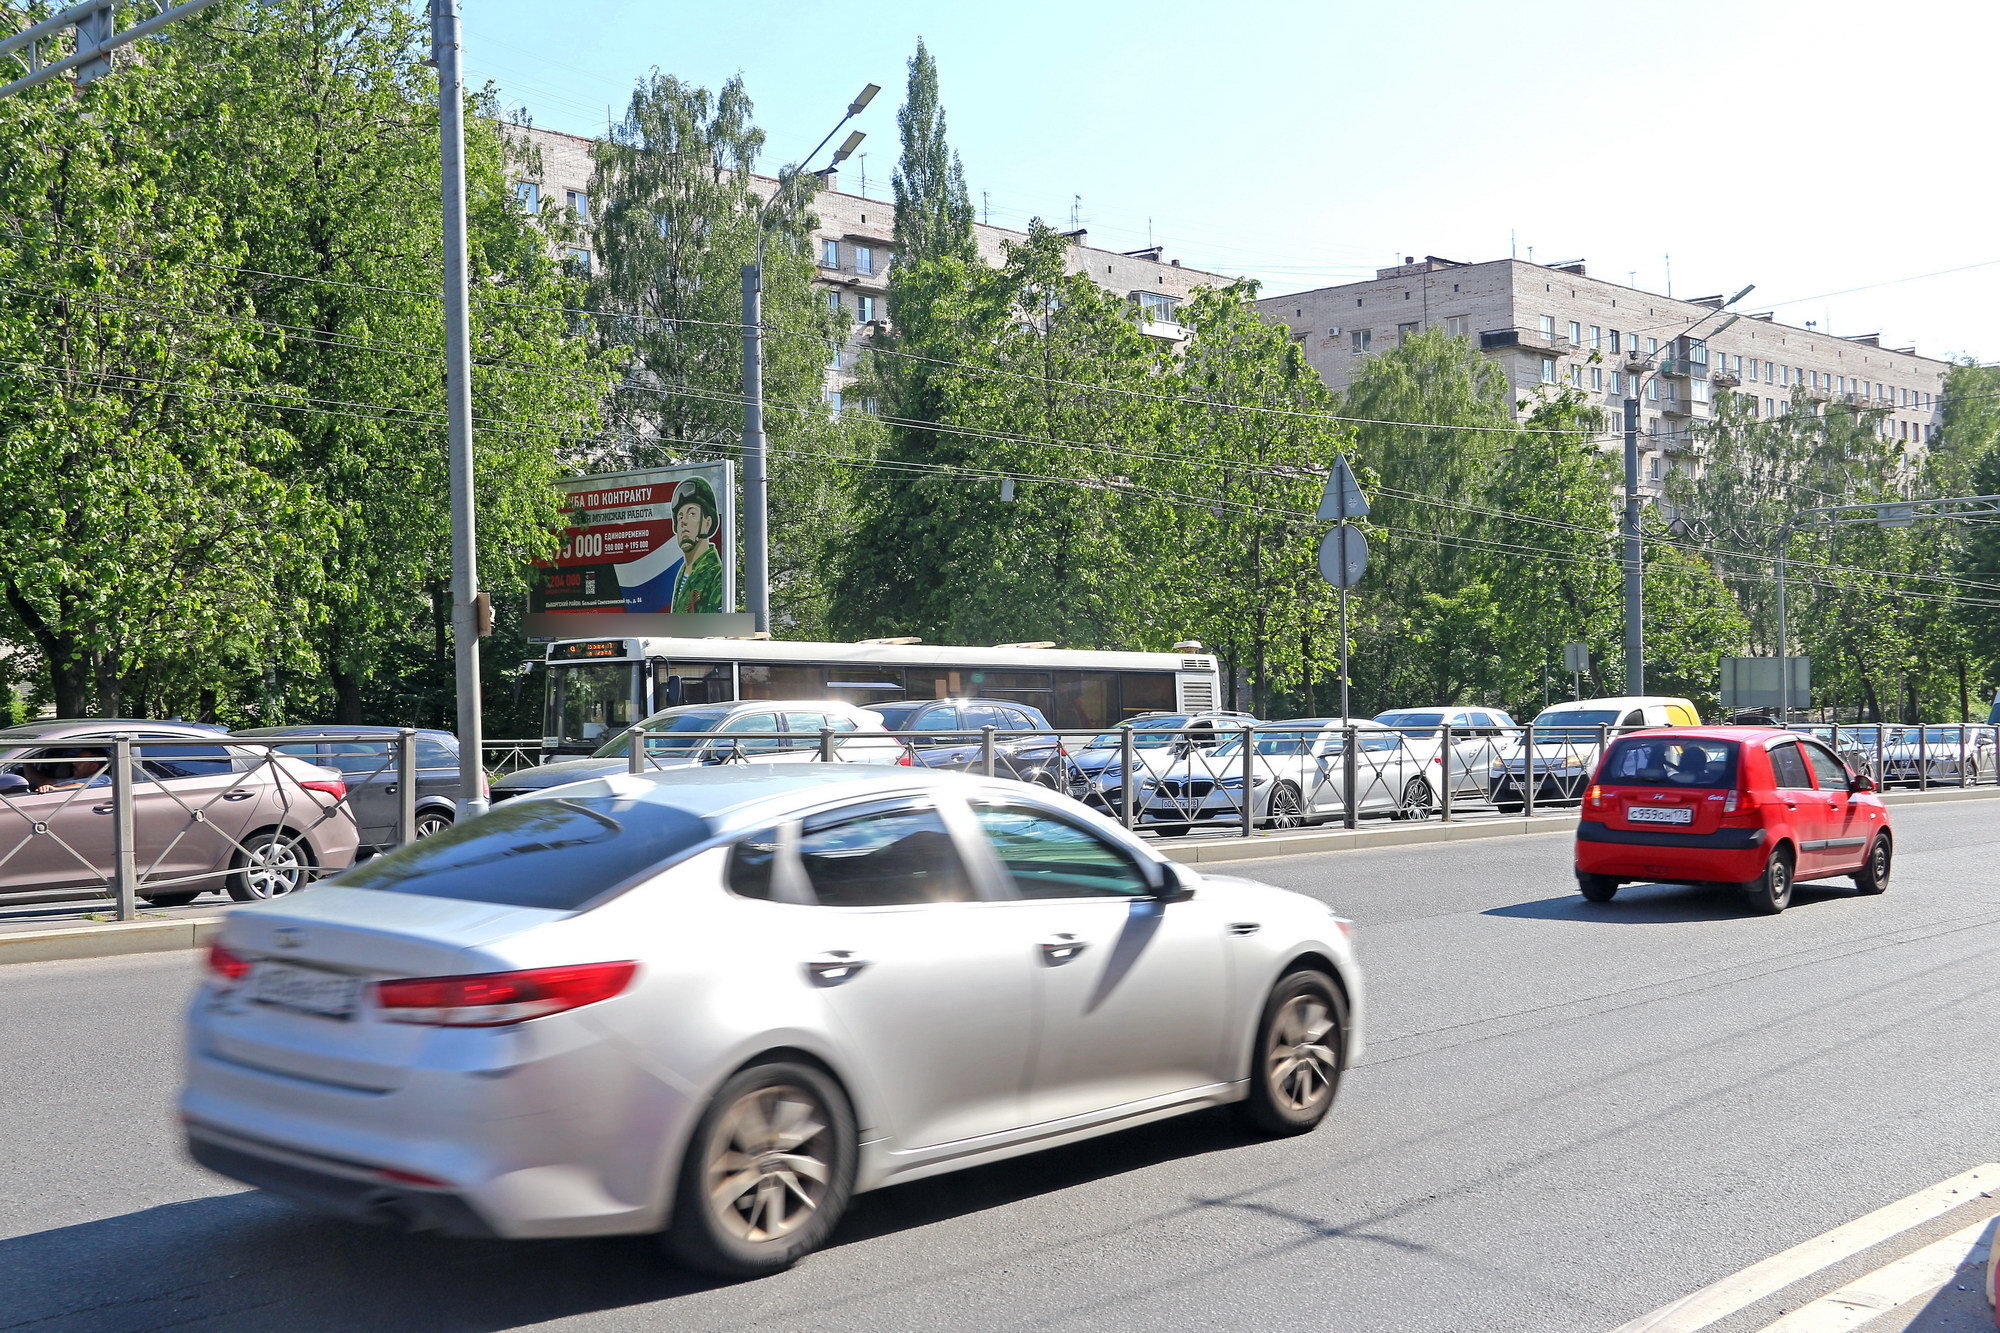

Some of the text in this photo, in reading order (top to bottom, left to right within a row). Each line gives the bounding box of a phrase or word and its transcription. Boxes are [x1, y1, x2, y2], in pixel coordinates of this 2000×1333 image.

[588, 494, 599, 507] ПО
[602, 488, 652, 505] КОНТРАКТУ
[592, 511, 626, 522] МУЖСКАЯ
[627, 508, 653, 519] РАБОТА
[605, 530, 649, 541] ЕДИНОВРЕМЕННО
[575, 533, 602, 558] 000
[630, 541, 639, 549] 195
[566, 574, 580, 586] 000
